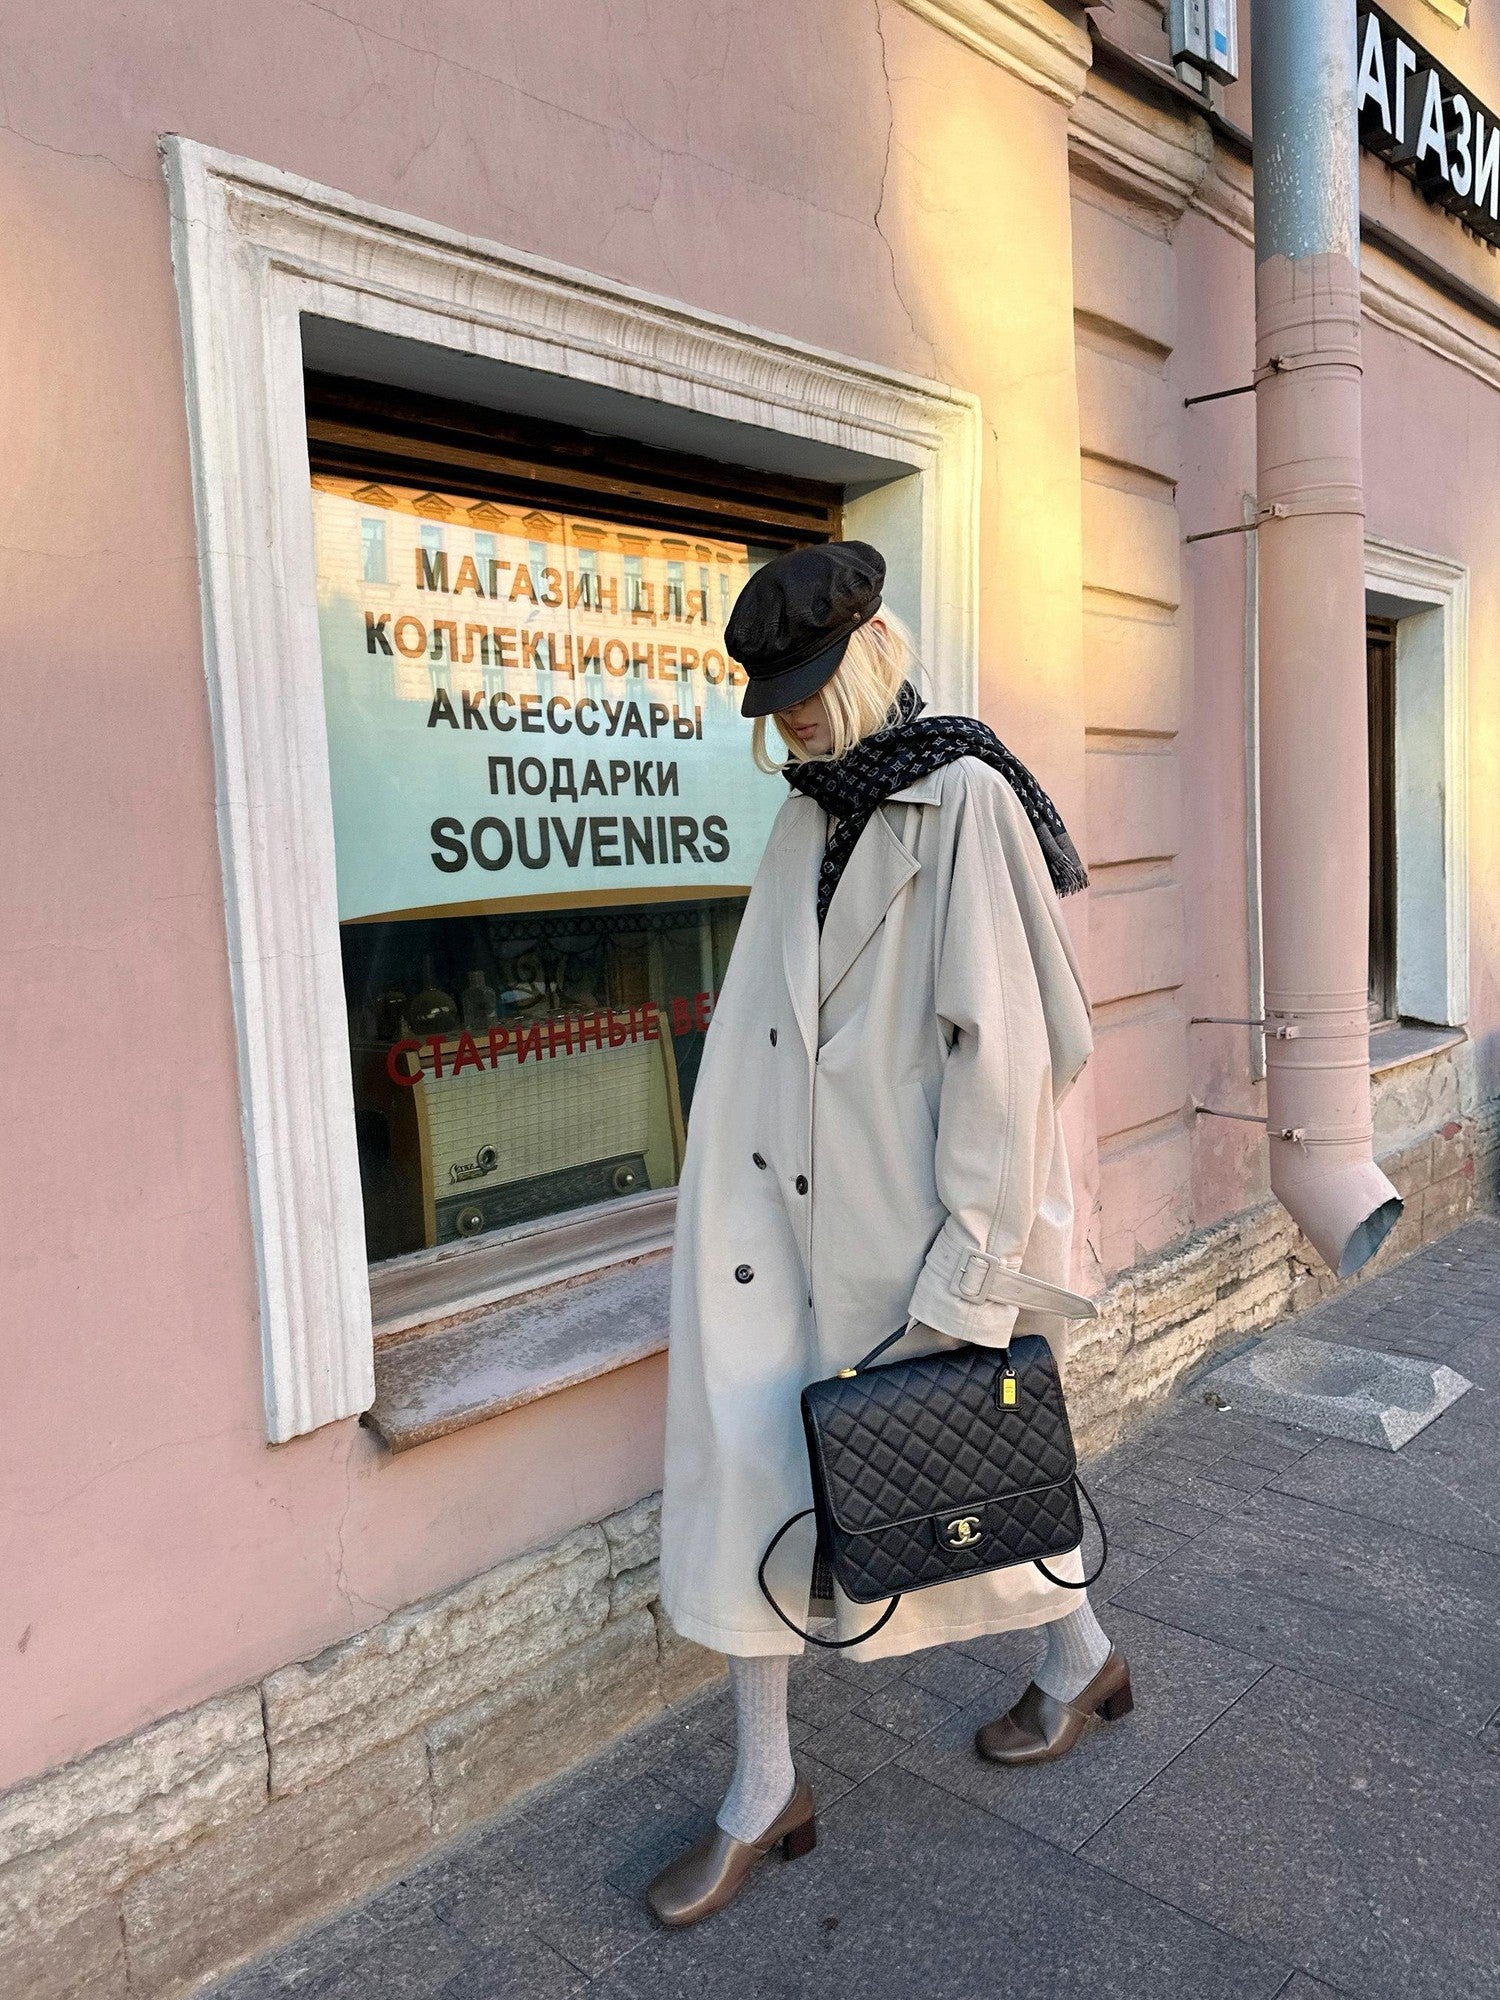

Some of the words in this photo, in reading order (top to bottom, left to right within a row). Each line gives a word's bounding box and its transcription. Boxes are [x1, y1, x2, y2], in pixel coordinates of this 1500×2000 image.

[414, 548, 619, 616] МАГАЗИН
[630, 580, 708, 627] ДЛЯ
[427, 688, 704, 741] АКСЕССУАРЫ
[487, 755, 680, 804] ПОДАРКИ
[429, 814, 731, 873] SOUVENIRS
[386, 1001, 660, 1087] СТАРИННЫЕ
[672, 989, 721, 1036] ВЕ
